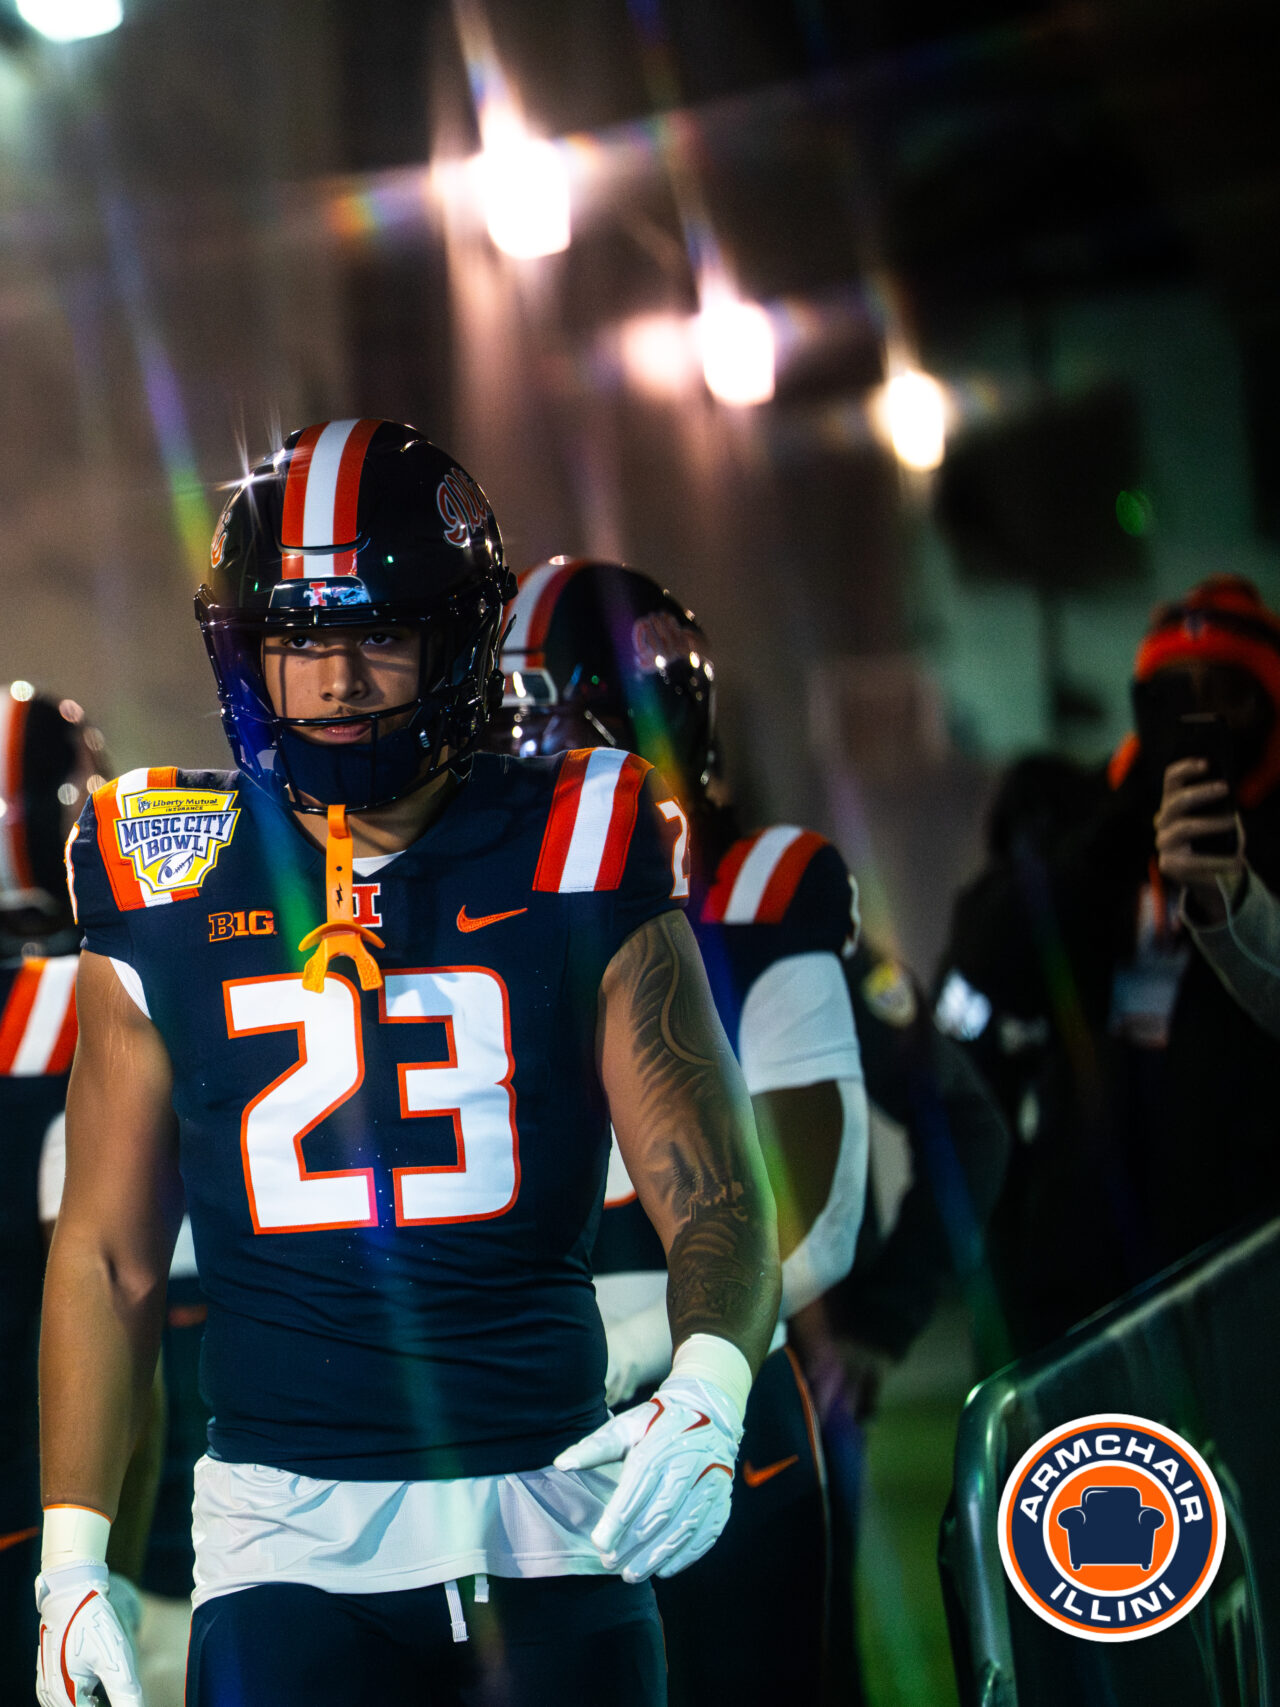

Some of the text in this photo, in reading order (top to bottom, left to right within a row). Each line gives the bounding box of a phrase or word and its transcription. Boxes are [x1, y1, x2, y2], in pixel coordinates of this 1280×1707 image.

[152, 799, 184, 807] Liberty
[122, 813, 232, 848] MUSIC CITY
[147, 835, 203, 860] BOWL
[222, 965, 520, 1236] 23
